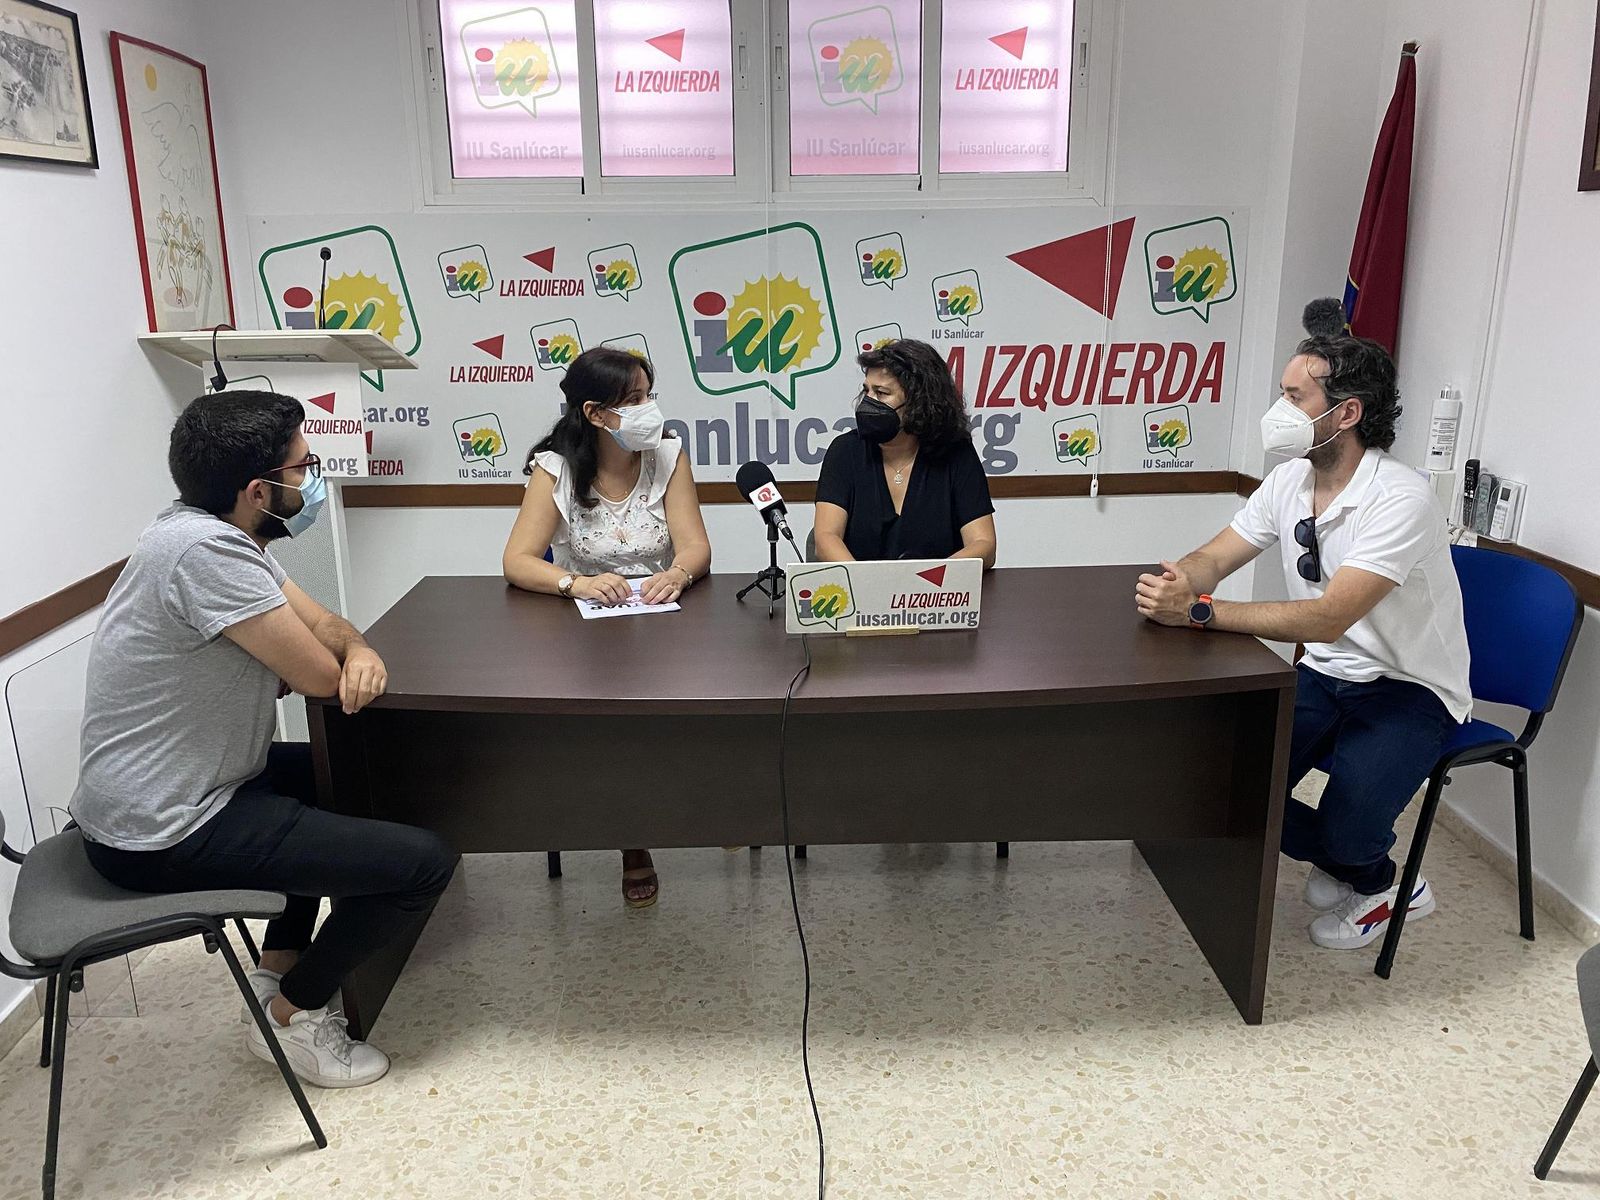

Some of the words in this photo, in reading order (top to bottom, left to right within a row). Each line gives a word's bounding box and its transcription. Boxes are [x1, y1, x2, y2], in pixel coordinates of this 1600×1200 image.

[615, 71, 634, 92] LA
[638, 70, 720, 93] IZQUIERDA
[955, 69, 975, 90] LA
[977, 68, 1058, 91] IZQUIERDA
[467, 142, 484, 160] IU
[491, 141, 568, 160] Sanlúcar
[623, 144, 715, 160] iusanlucar.org
[807, 139, 823, 157] IU
[830, 138, 905, 156] Sanlúcar
[959, 141, 1049, 157] iusanlucar.org
[500, 280, 516, 296] LA
[518, 279, 584, 297] IZQUIERDA
[932, 329, 941, 339] IU
[944, 328, 984, 339] Sanlúcar
[450, 366, 465, 382] LA
[468, 366, 533, 383] IZQUIERDA
[974, 342, 1225, 412] IZQUIERDA
[363, 405, 430, 427] ar.org
[303, 419, 362, 435] IZQUIERDA
[1143, 459, 1153, 468] IU
[1155, 458, 1193, 468] Sanlúcar
[459, 469, 468, 478] IU
[472, 469, 512, 478] Sanlúcar
[891, 594, 906, 608] LA
[908, 592, 969, 608] IZQUIERDA
[856, 610, 978, 627] iusanlucar.org
